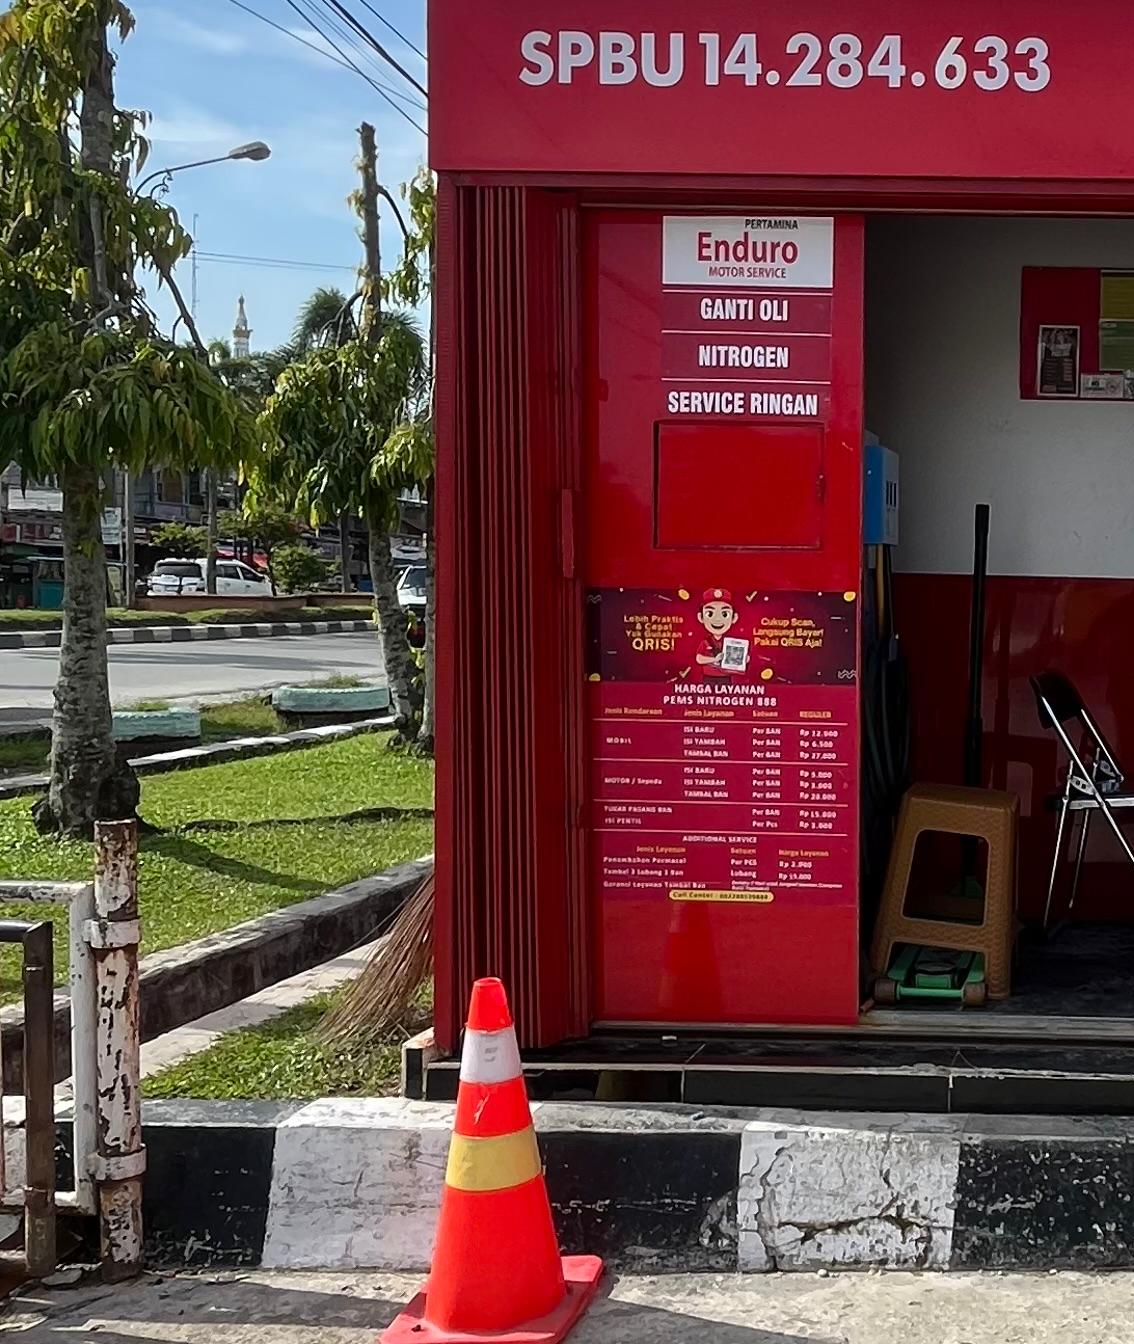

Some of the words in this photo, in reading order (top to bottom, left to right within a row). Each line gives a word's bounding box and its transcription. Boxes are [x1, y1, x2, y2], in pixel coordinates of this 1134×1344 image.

[519, 30, 684, 86] SPBU
[698, 31, 1050, 91] 14.284.633
[745, 219, 798, 230] PERTAMINA
[697, 232, 799, 263] Enduro
[708, 267, 745, 278] MOTOR
[747, 267, 786, 279] SERVICE
[700, 297, 754, 320] GANTI
[759, 299, 789, 321] OLI
[698, 344, 789, 368] NITROGEN
[668, 391, 745, 413] SERVICE
[750, 393, 818, 416] RINGAN
[761, 617, 790, 627] Cukup
[632, 638, 675, 651] QRIS!
[675, 684, 712, 694] HARGA
[714, 684, 765, 695] LAYANAN
[696, 696, 753, 706] NITROGEN
